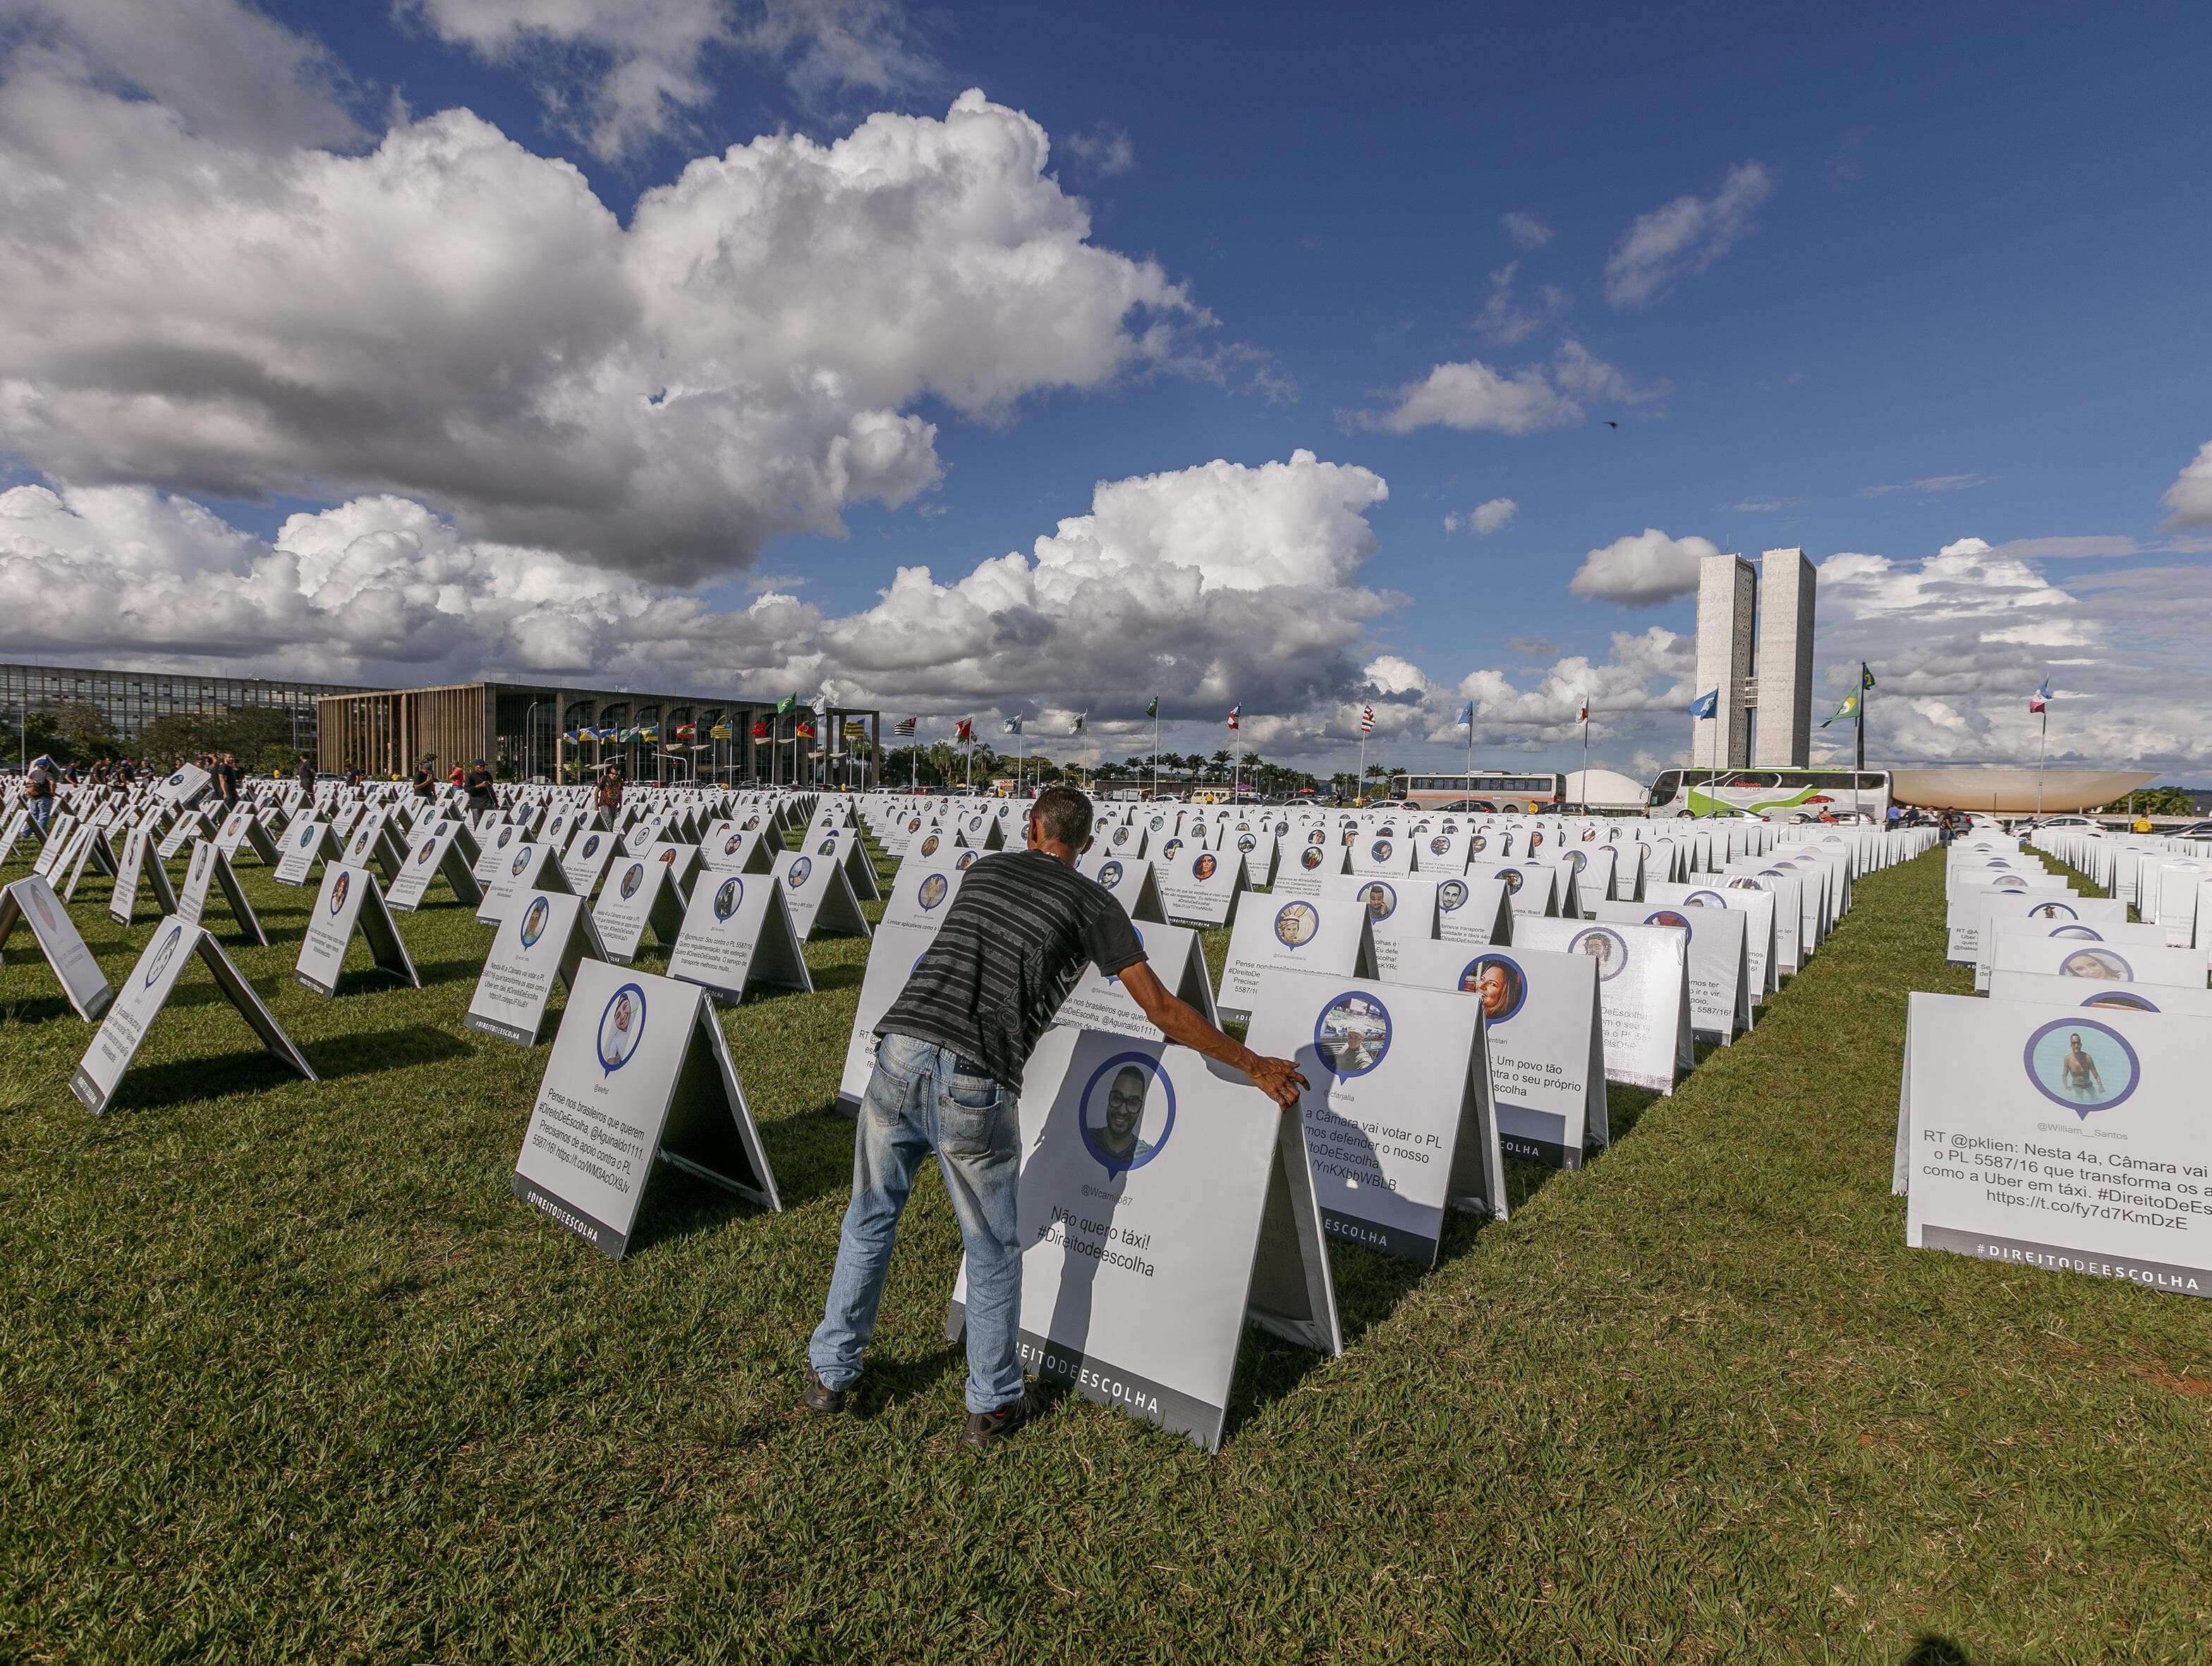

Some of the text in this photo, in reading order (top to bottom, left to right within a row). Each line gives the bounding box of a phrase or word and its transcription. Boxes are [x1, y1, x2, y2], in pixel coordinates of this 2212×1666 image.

[901, 921, 922, 930] aplicativos
[508, 966, 521, 975] Câmara
[700, 961, 718, 970] melhorou
[727, 959, 741, 967] serviço
[1086, 1002, 1116, 1015] brasileiros
[1117, 1009, 1130, 1018] que
[1697, 1006, 1732, 1017] 5587/16!
[475, 1021, 520, 1040] #DIREITODEESCOLHA
[859, 1030, 870, 1039] RT
[1497, 1055, 1562, 1074] Um povo tão
[1521, 1074, 1540, 1085] seu
[1543, 1078, 1581, 1091] próprio
[547, 1088, 645, 1141] Pense nos brasileiros que querem
[1306, 1109, 1443, 1149] a Câmara vai votar o PL
[532, 1134, 556, 1155] 5587/16!
[538, 1102, 643, 1161] #DireitoDeEscolha, @Aguinaldo1111.
[1330, 1129, 1380, 1151] defender
[1382, 1144, 1390, 1154] o
[1393, 1145, 1430, 1164] nosso
[539, 1119, 631, 1175] Precisamos de apoio contra o PL
[1924, 1129, 2208, 1178] RT @pklien: Nesta 4a, Câmara vai
[1923, 1165, 1964, 1180] como
[1969, 1171, 1979, 1182] a
[1984, 1172, 2022, 1189] Uber
[2027, 1180, 2053, 1193] em
[2058, 1182, 2092, 1198] táxi.
[1933, 1149, 1943, 1160] o
[1948, 1149, 1969, 1164] PL
[1974, 1153, 2038, 1174] 5587/16
[2043, 1164, 2074, 1179] que
[2080, 1168, 2171, 1193] transforma
[2177, 1182, 2198, 1196] os
[527, 1191, 598, 1242] #DIREITODEESCOLHA
[1050, 1205, 1151, 1251] Não quero táxi!
[1325, 1218, 1387, 1246] ESCOLHA
[1038, 1224, 1155, 1278] #Direitodeescolha
[1976, 1244, 2199, 1291] #DIREITODEESCOLHA
